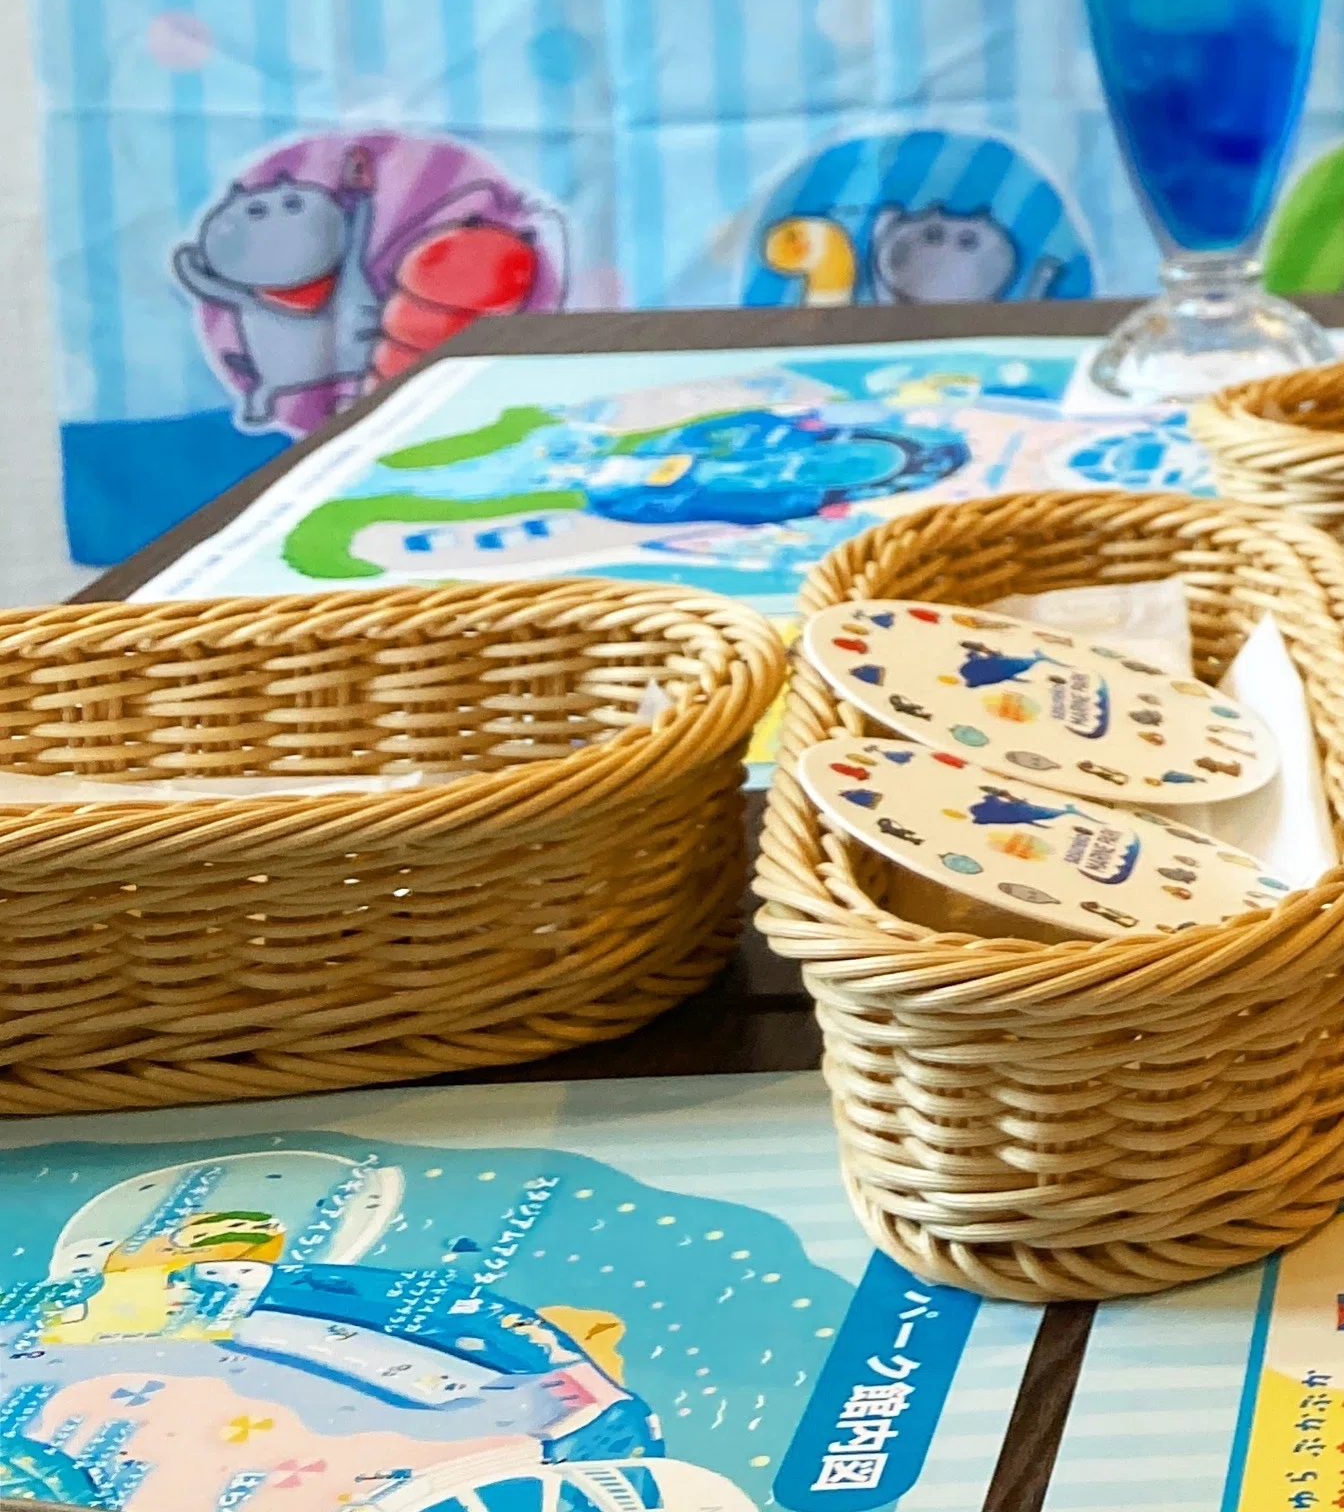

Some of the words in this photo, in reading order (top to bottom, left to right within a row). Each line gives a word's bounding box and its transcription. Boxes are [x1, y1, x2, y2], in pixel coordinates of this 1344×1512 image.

[810, 1289, 942, 1492] パーク館内図
